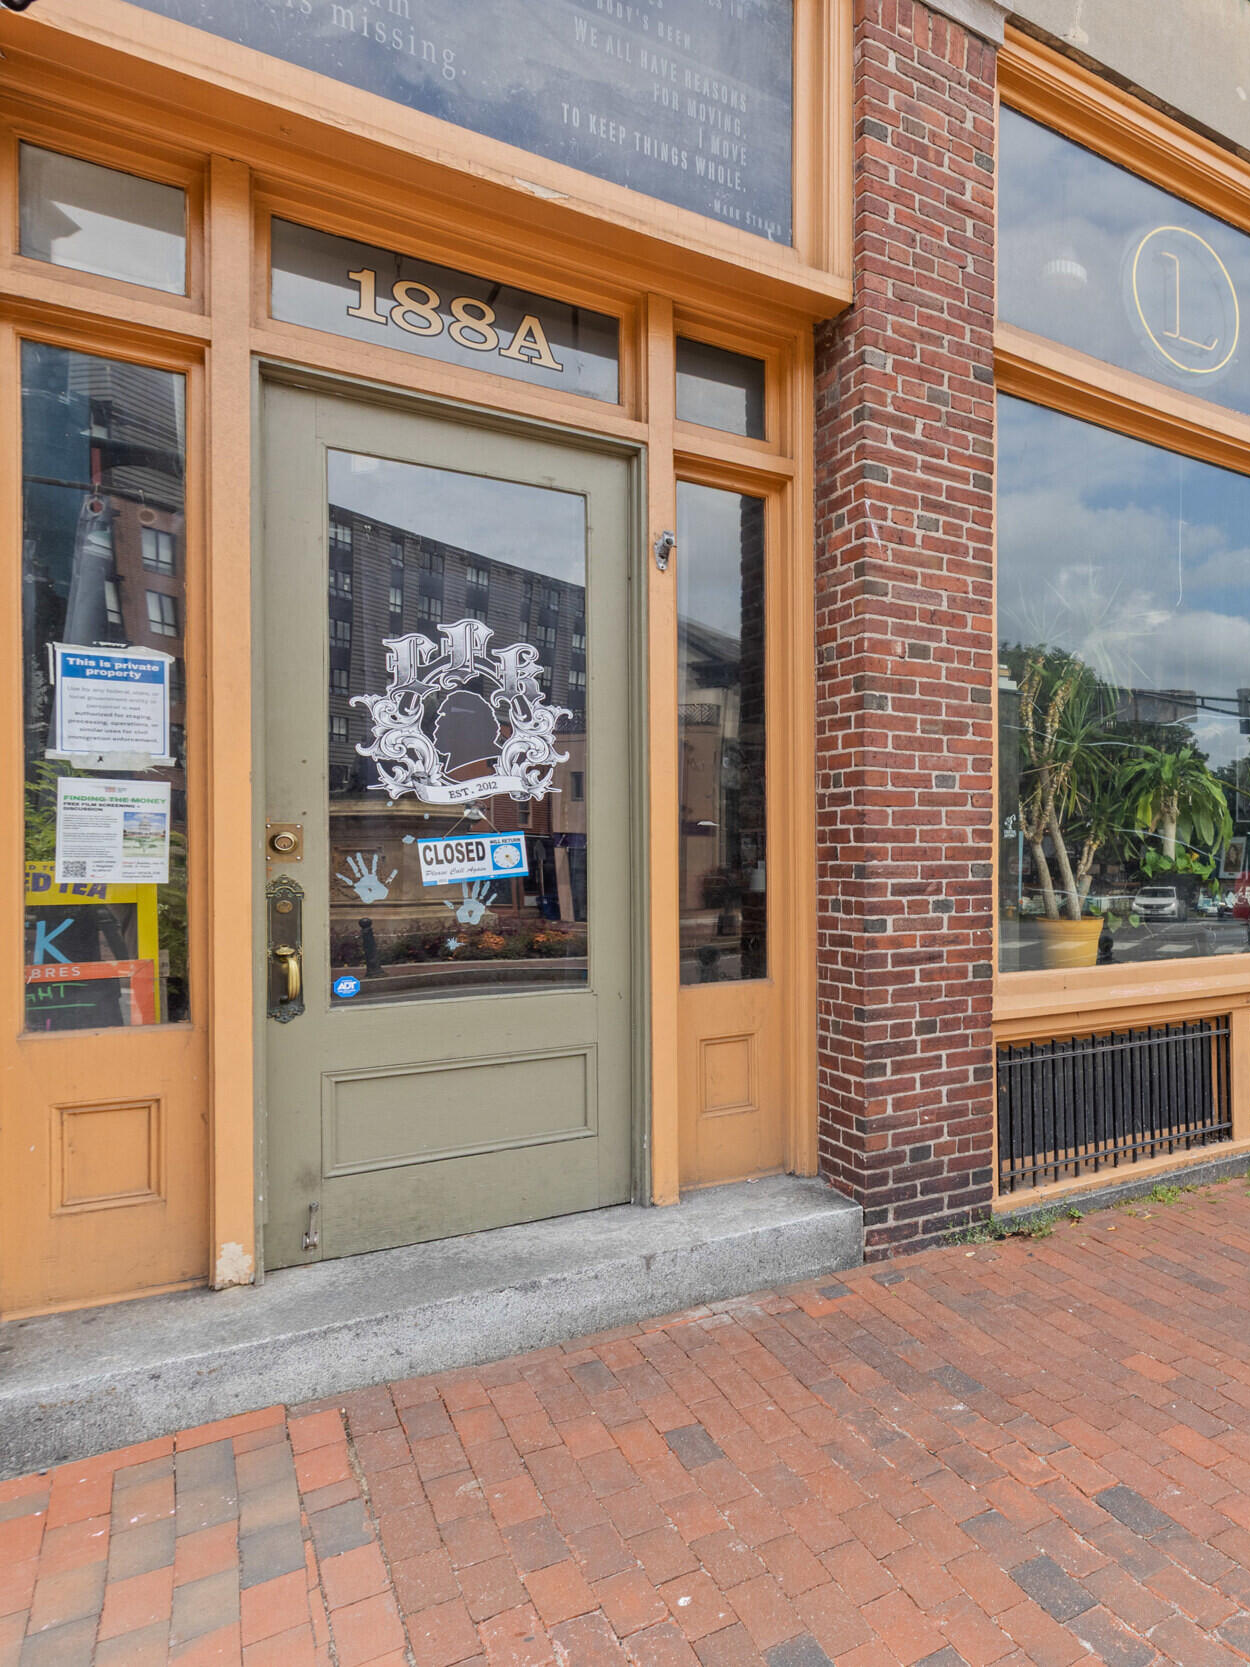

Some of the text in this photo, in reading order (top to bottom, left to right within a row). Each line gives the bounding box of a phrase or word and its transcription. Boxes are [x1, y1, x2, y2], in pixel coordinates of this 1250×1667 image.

[332, 3, 467, 81] missing.
[574, 15, 747, 113] WE ALL HAVE REASONS
[653, 83, 748, 140] FOR MOVING.
[561, 102, 748, 193] TO KEEP THINGS WHOLE.
[698, 128, 747, 167] I MOVE
[347, 267, 564, 373] 188A
[67, 656, 160, 672] This is private
[85, 668, 143, 680] property
[63, 794, 106, 802] FINDING
[477, 781, 498, 792] 2012
[422, 840, 486, 866] CLOSED
[337, 981, 358, 991] ADT
